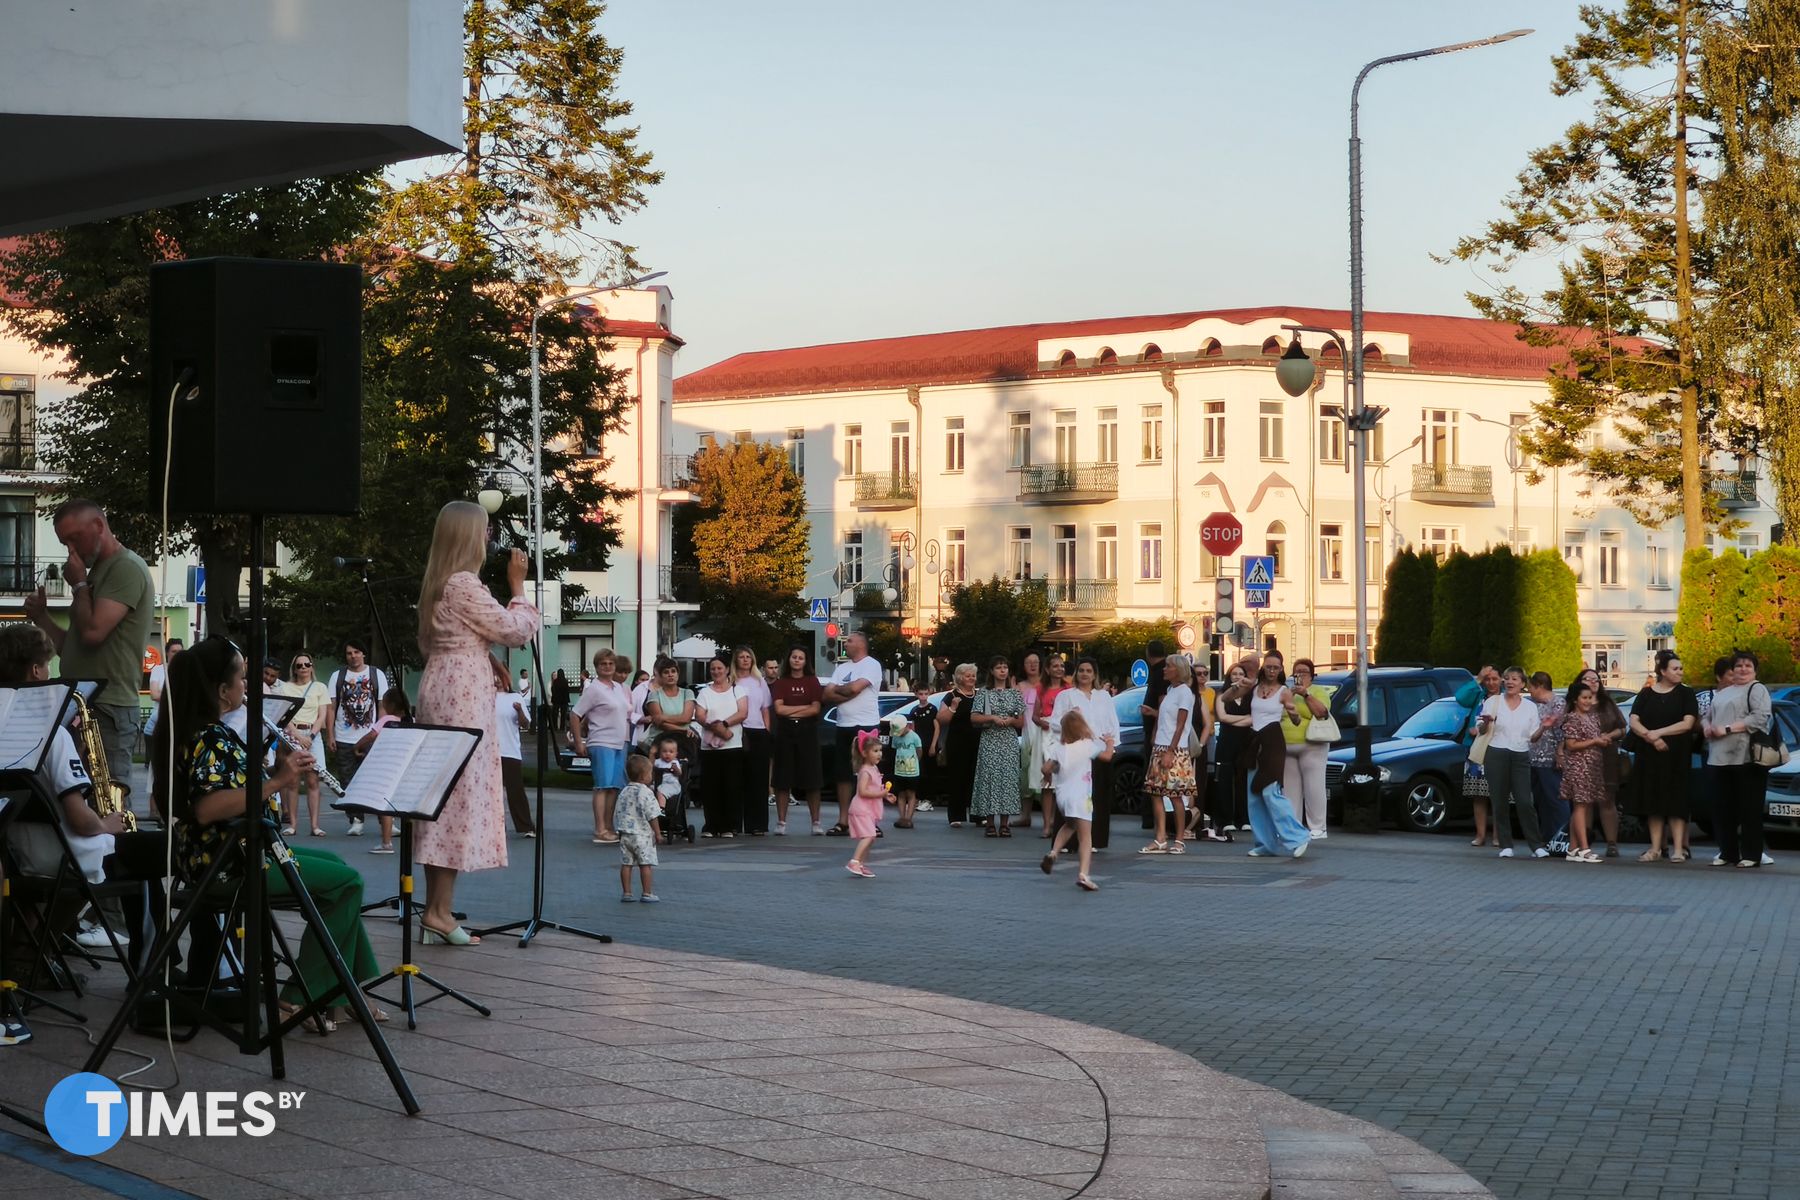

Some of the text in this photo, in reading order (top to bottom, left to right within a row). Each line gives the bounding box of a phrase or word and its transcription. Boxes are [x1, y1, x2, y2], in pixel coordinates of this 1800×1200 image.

[1202, 527, 1241, 541] STOP
[572, 595, 622, 613] BANK
[69, 759, 86, 778] 5
